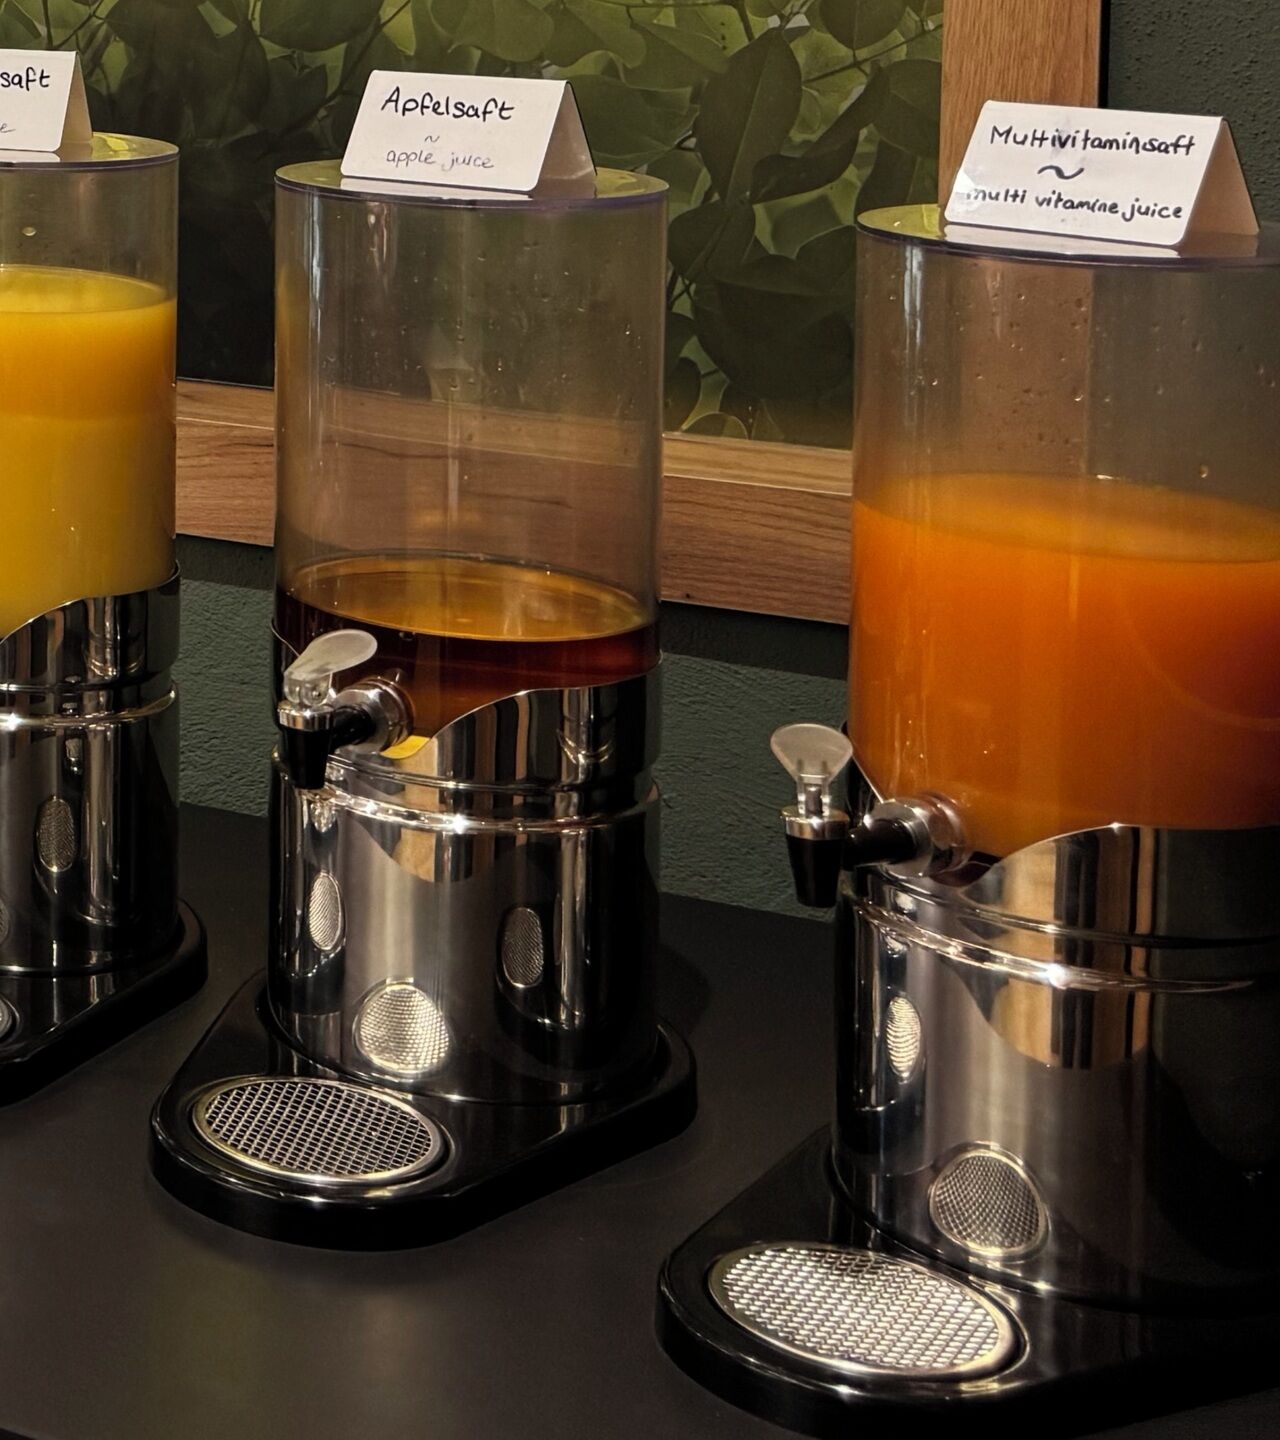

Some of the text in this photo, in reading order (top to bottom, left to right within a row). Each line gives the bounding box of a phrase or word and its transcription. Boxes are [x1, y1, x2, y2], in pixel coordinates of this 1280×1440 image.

[380, 86, 516, 122] Apfelsaft
[989, 124, 1196, 157] Multivitaminsaft
[386, 149, 495, 172] apple juice
[965, 188, 1028, 204] multi
